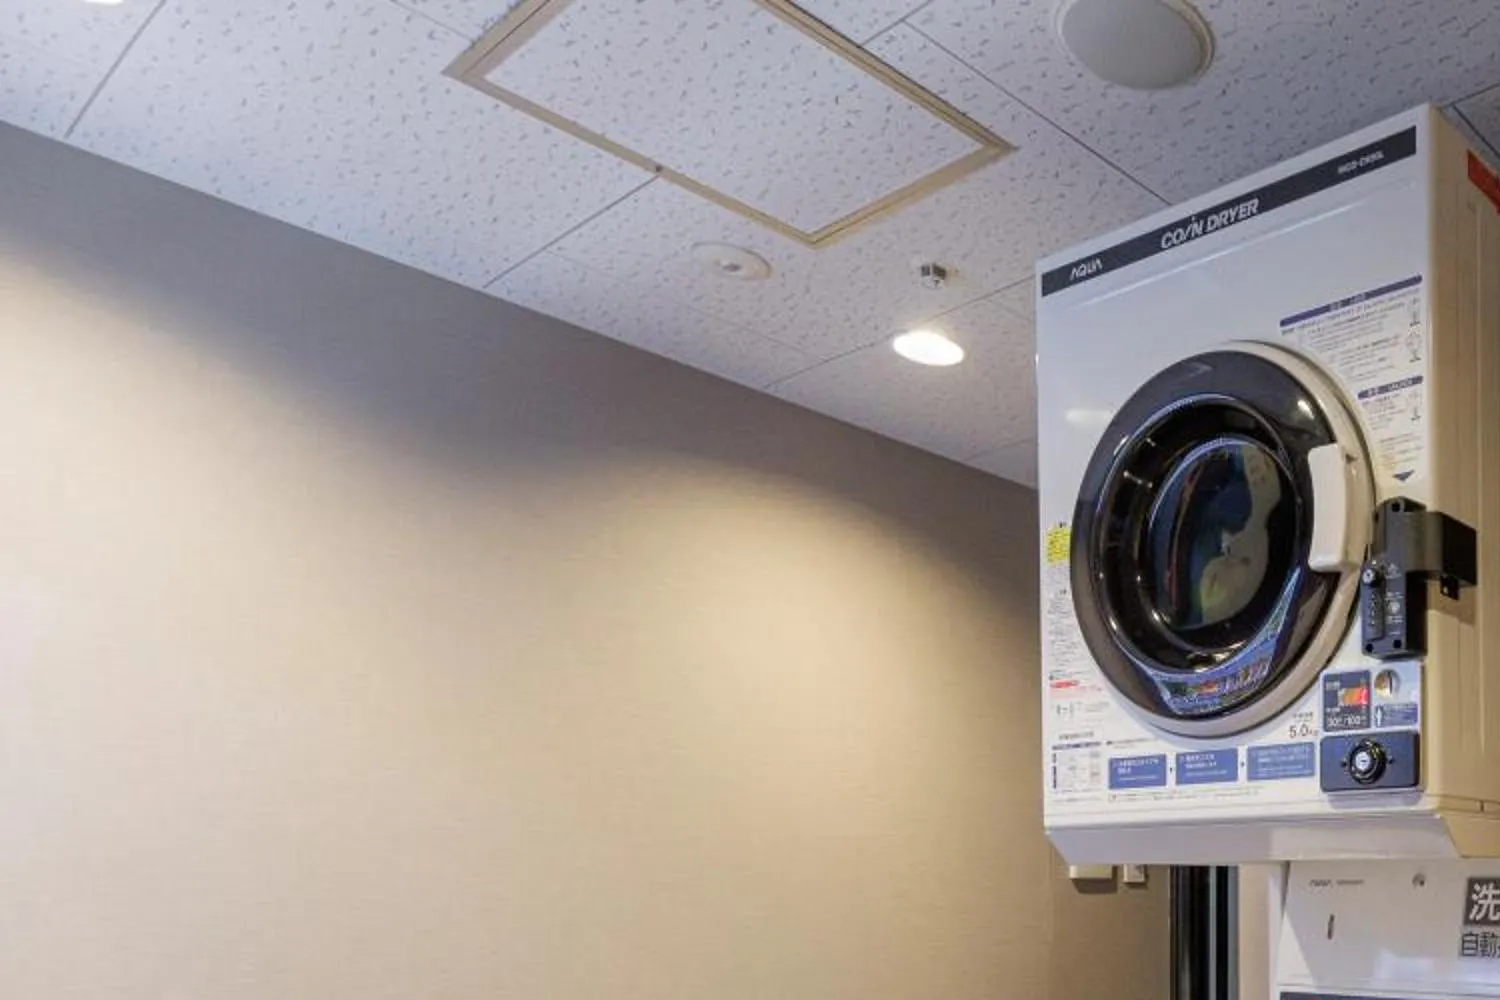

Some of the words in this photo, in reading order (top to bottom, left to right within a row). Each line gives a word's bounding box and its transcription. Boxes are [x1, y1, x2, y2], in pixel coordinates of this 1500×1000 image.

[1161, 214, 1203, 249] COIN
[1207, 198, 1259, 233] DRYER
[1069, 257, 1102, 281] AQUA
